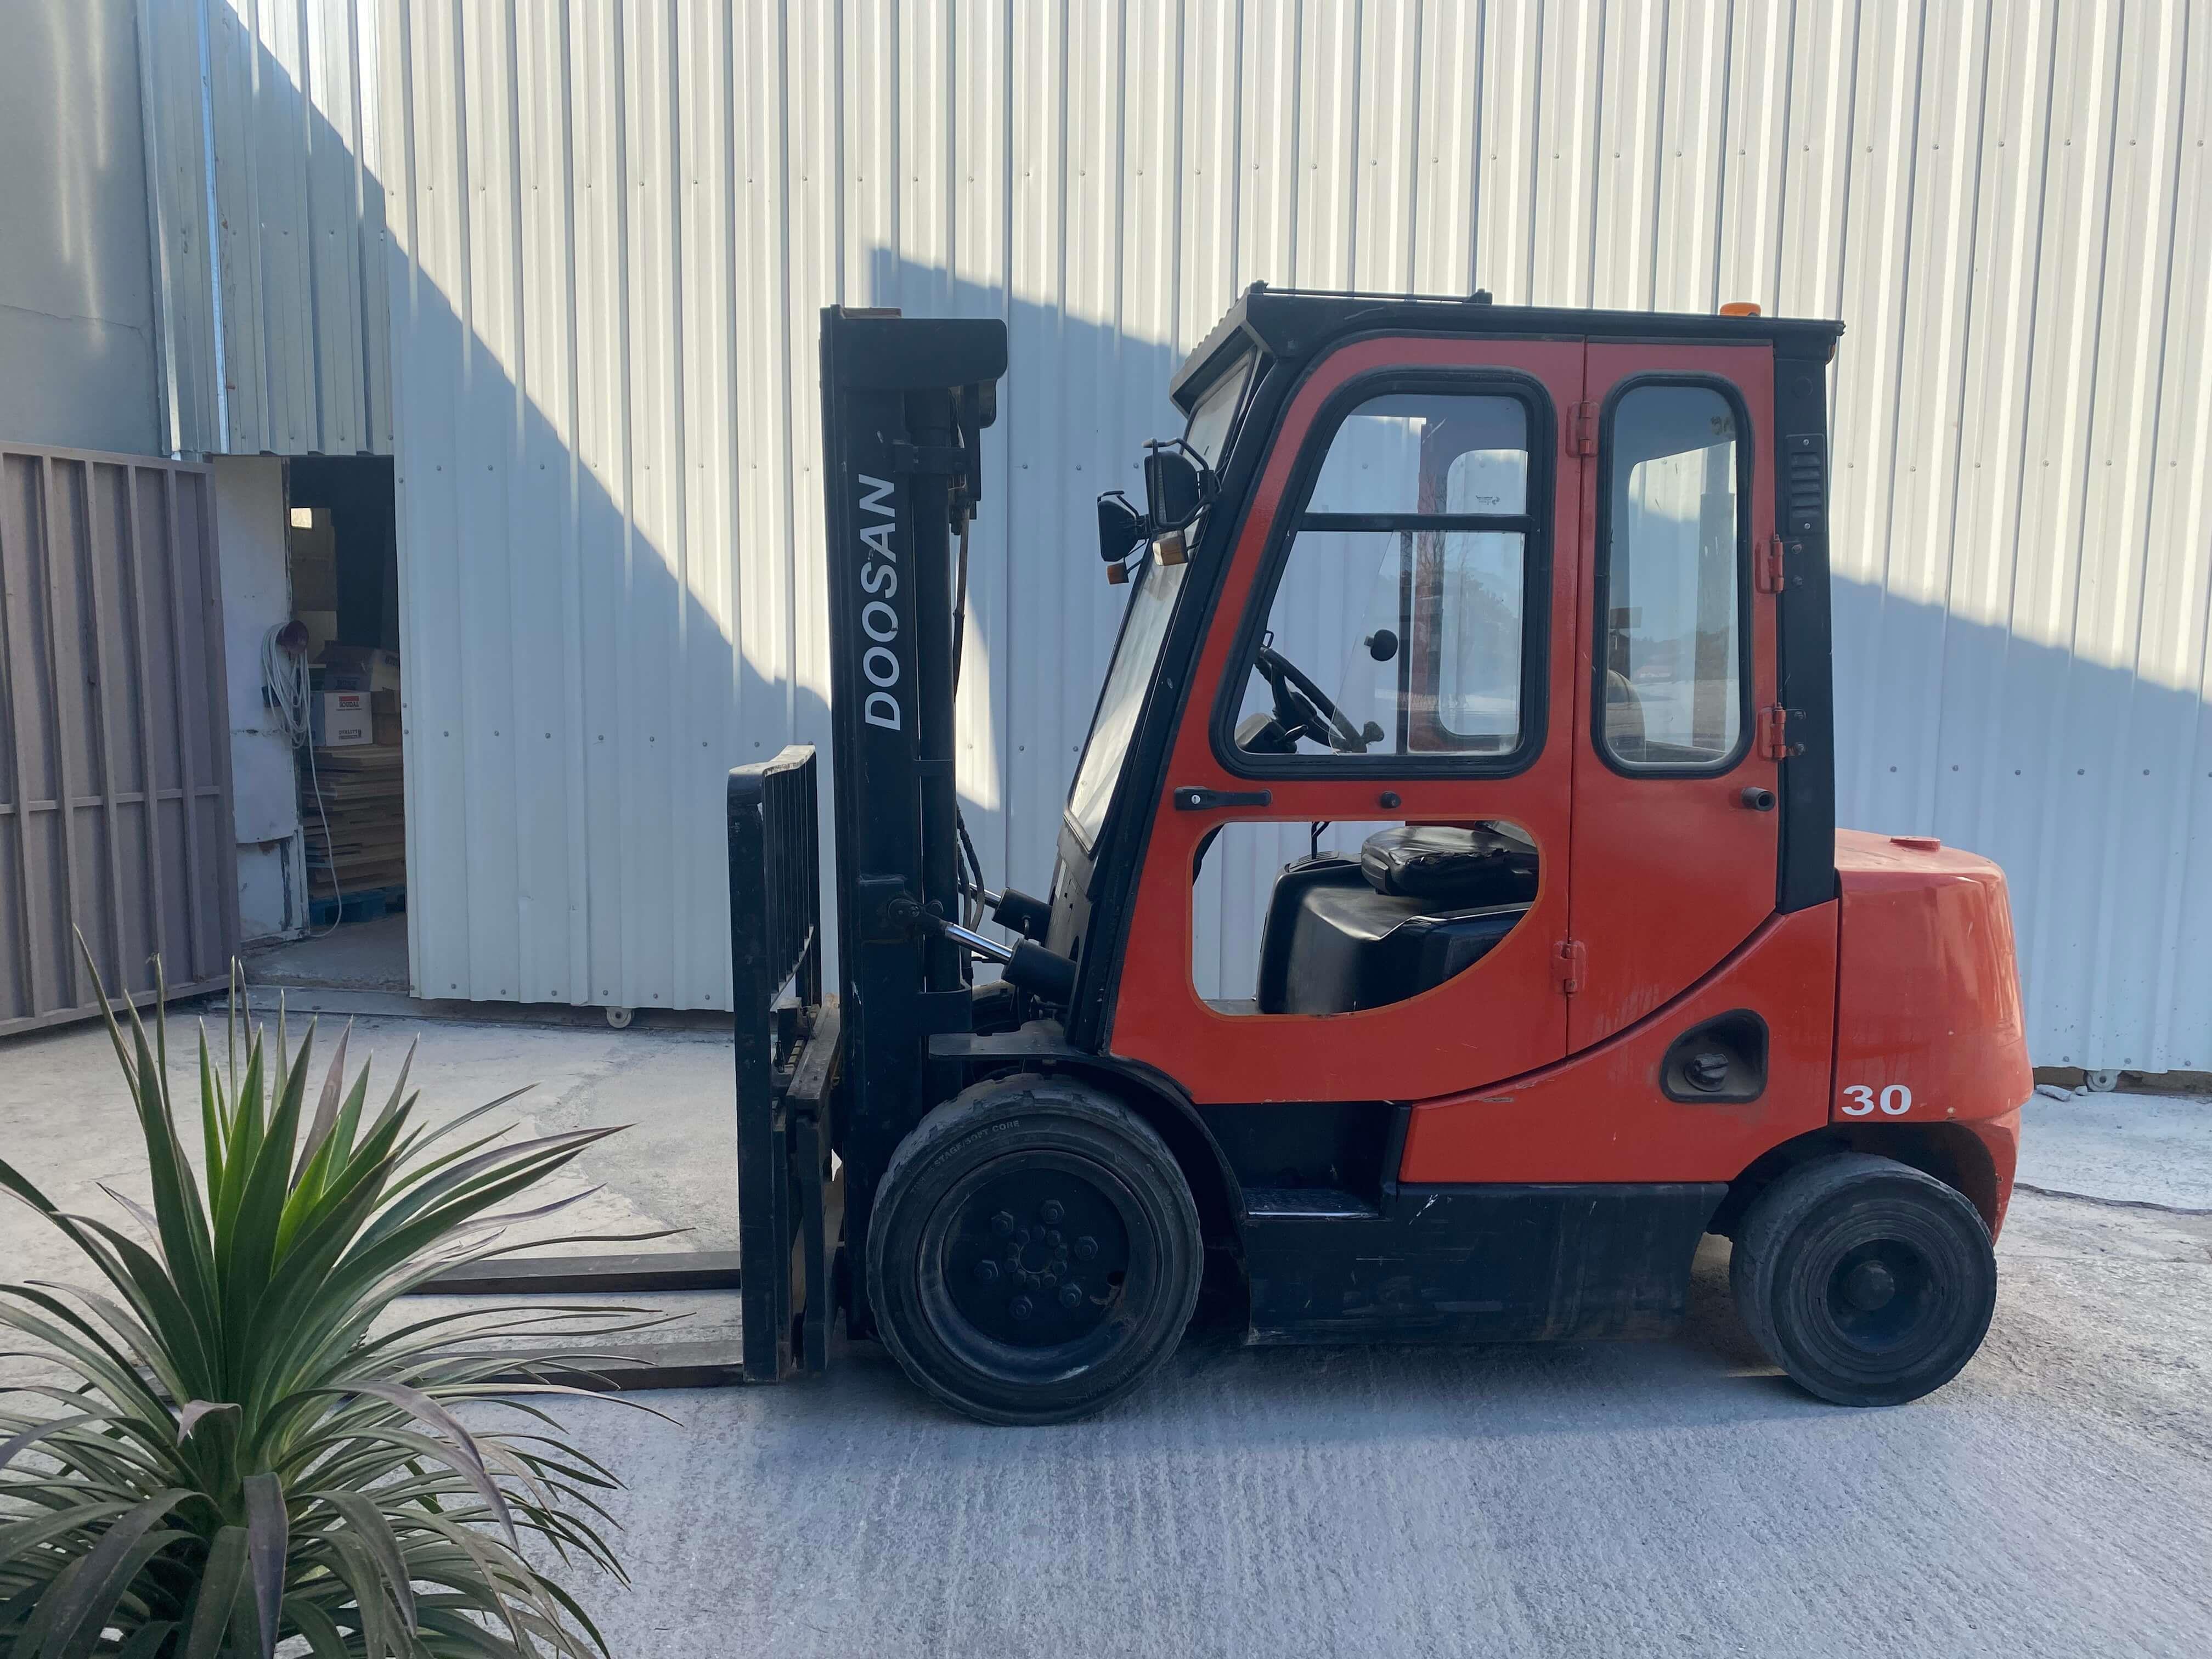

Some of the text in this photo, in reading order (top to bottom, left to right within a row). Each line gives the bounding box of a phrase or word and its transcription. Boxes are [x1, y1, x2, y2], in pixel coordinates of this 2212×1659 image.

[858, 473, 901, 731] DOOSAN
[1841, 1085, 1912, 1116] 30
[991, 1120, 1020, 1132] CORE
